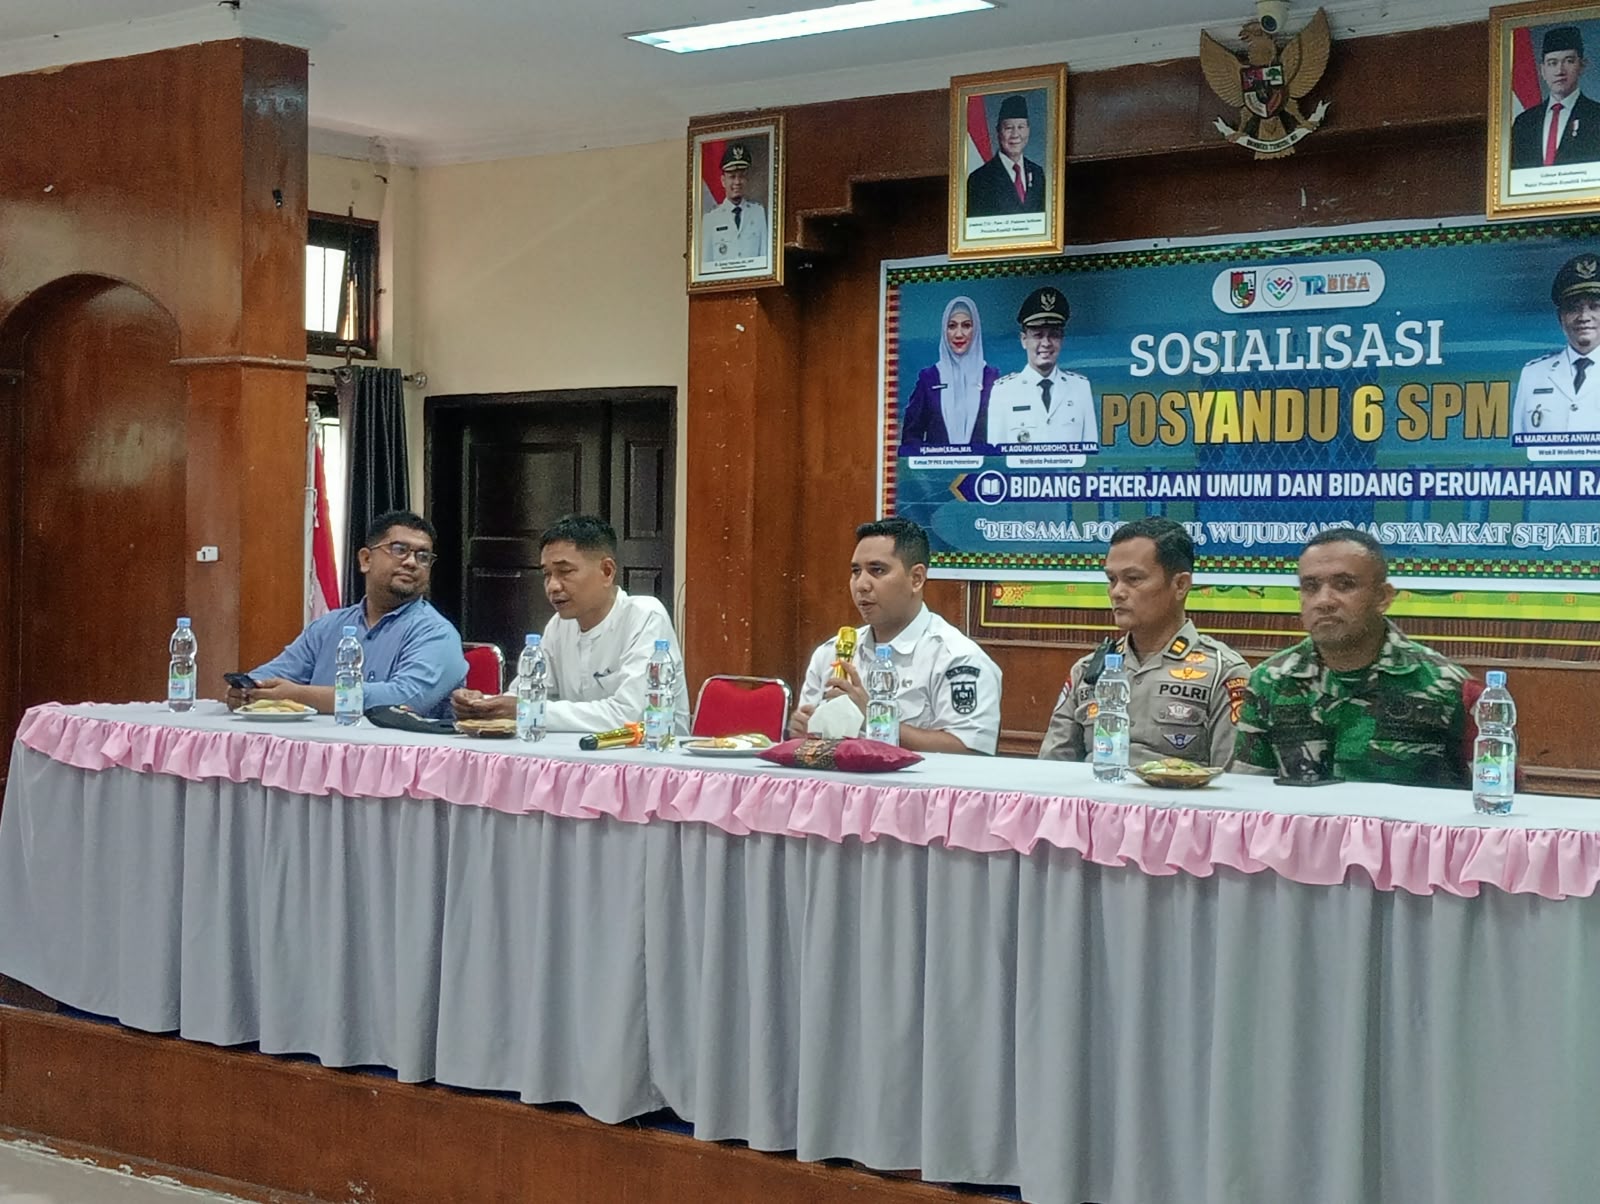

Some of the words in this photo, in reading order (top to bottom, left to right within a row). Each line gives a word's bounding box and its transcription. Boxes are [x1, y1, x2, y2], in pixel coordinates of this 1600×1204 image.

[1129, 319, 1445, 377] SOSIALISASI
[1101, 386, 1340, 448] POSYANDU
[1350, 385, 1386, 443] 6
[1395, 380, 1512, 442] SPM
[1008, 444, 1033, 453] AGUNG
[1524, 434, 1570, 443] MARKARIUS
[1010, 475, 1081, 498] BIDANG
[1085, 473, 1201, 498] PEKERJAAN
[1206, 473, 1272, 497] UMUM
[1278, 473, 1322, 497] DAN
[1328, 472, 1413, 497] BIDANG
[1420, 470, 1572, 497] PERUMAHAN
[1158, 683, 1208, 701] POLRI
